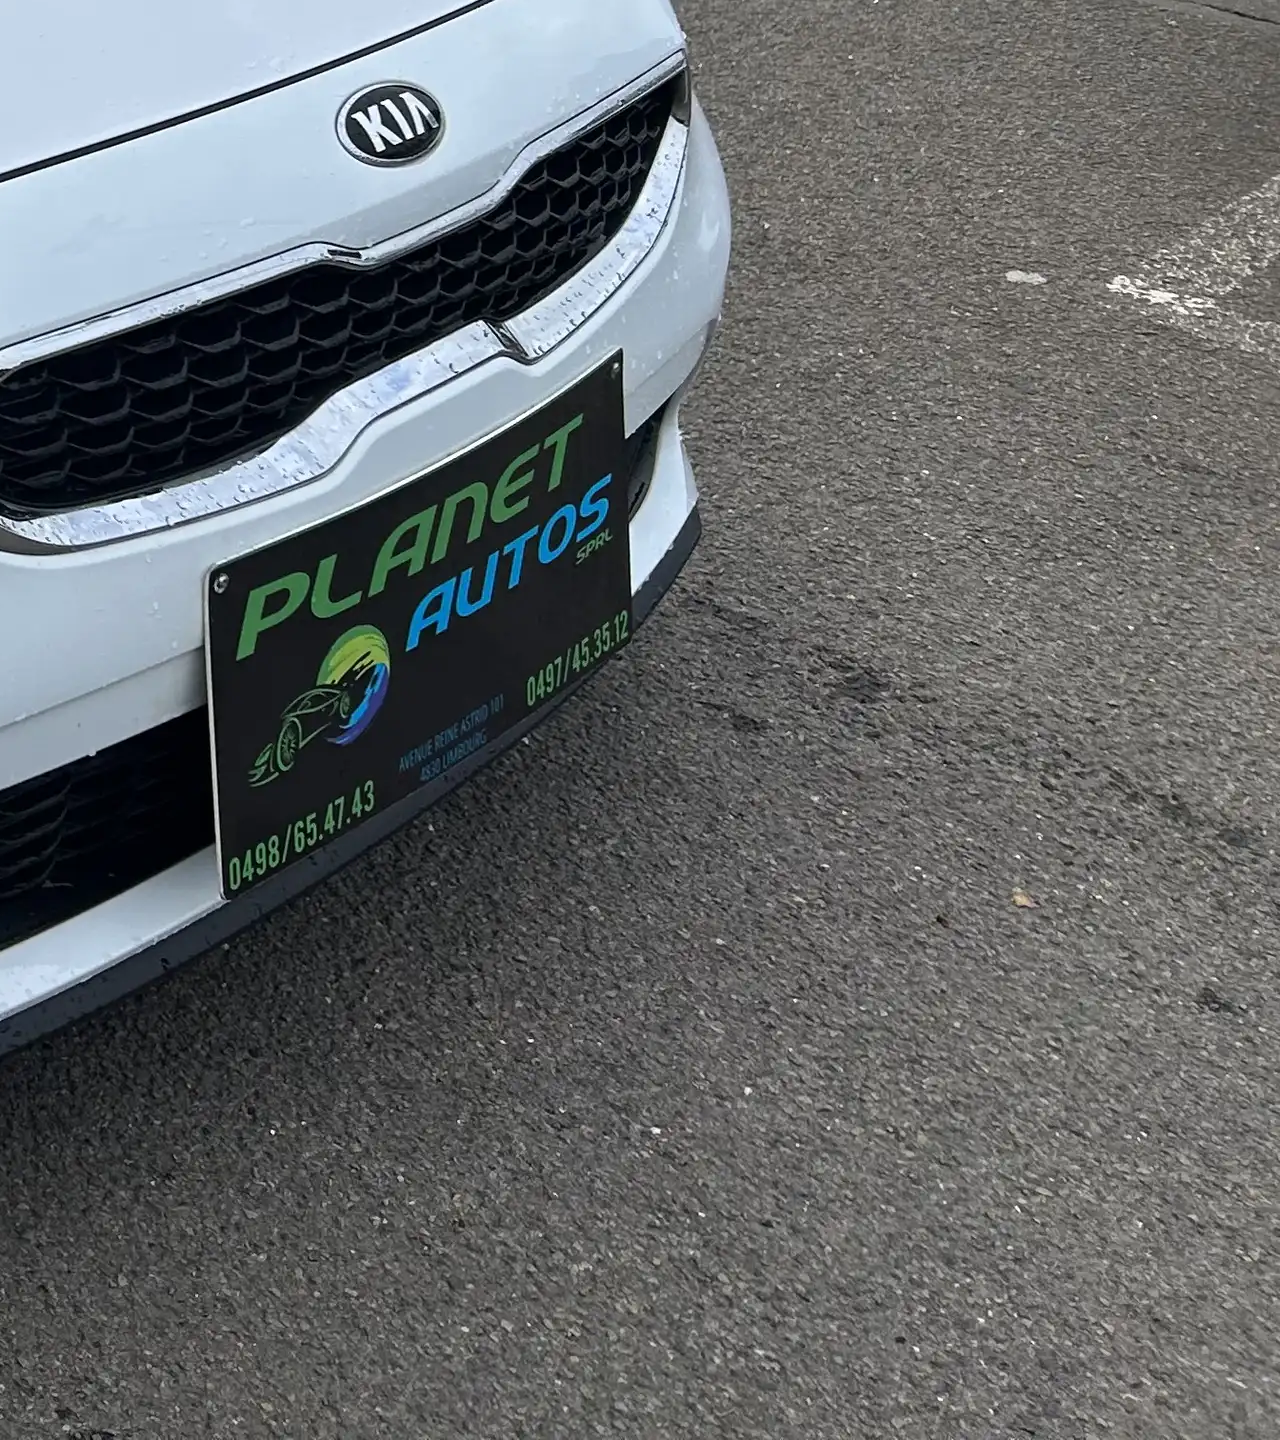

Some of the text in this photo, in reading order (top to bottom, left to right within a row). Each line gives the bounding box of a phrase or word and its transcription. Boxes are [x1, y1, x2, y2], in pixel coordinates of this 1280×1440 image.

[351, 91, 439, 153] KIA
[235, 413, 584, 662] PLANET
[405, 472, 613, 653] AUTOS
[575, 527, 613, 566] SPRL
[525, 609, 629, 707] 0497/45.35.12
[398, 693, 505, 774] AVENUE REINE ASTRID 101
[442, 728, 487, 770] LIMBOURG
[227, 779, 376, 892] 0498/65.47.43
